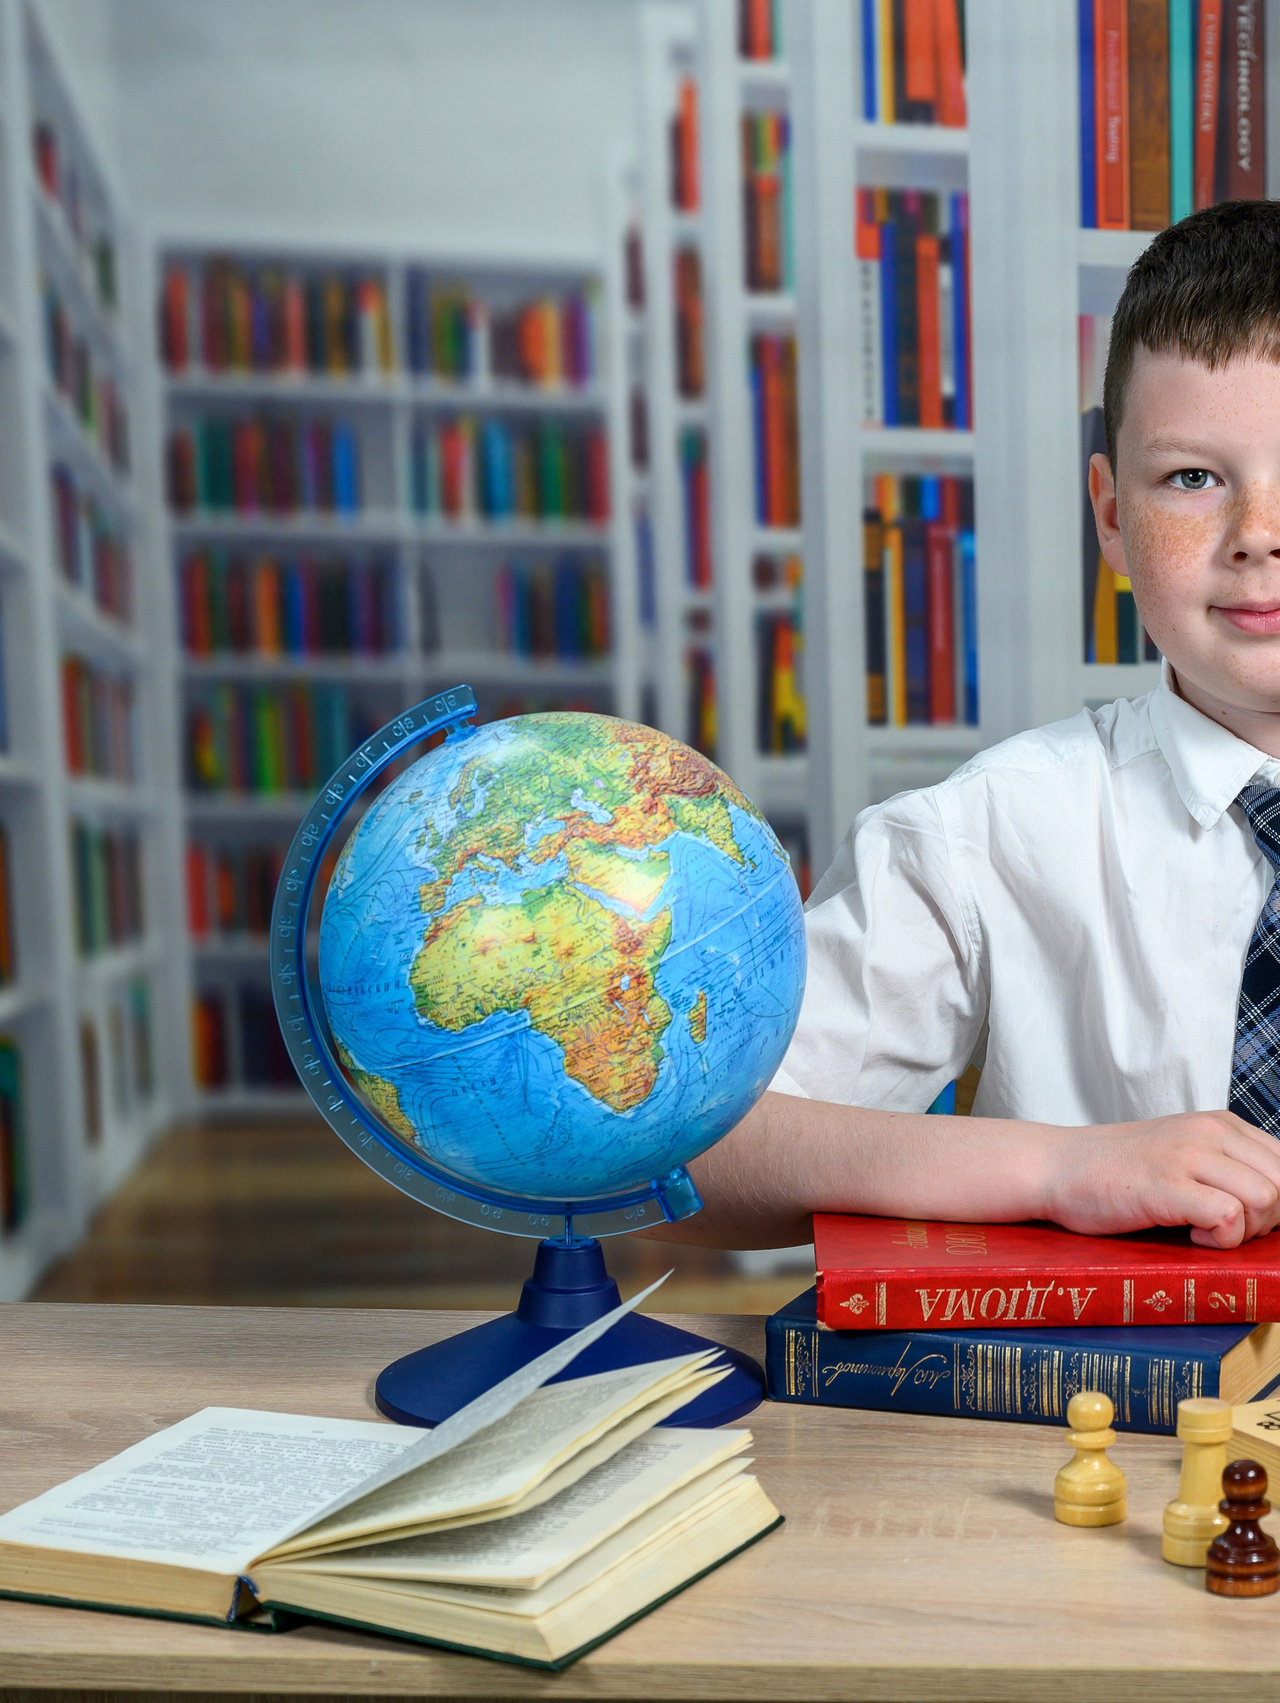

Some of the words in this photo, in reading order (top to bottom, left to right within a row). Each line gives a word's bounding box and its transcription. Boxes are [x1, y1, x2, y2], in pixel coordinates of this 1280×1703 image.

[1236, 2, 1252, 172] TECHNOLOGY
[914, 1280, 1056, 1321] ДЮМА
[1208, 1291, 1236, 1313] 2
[821, 1341, 948, 1396] Лермонтов
